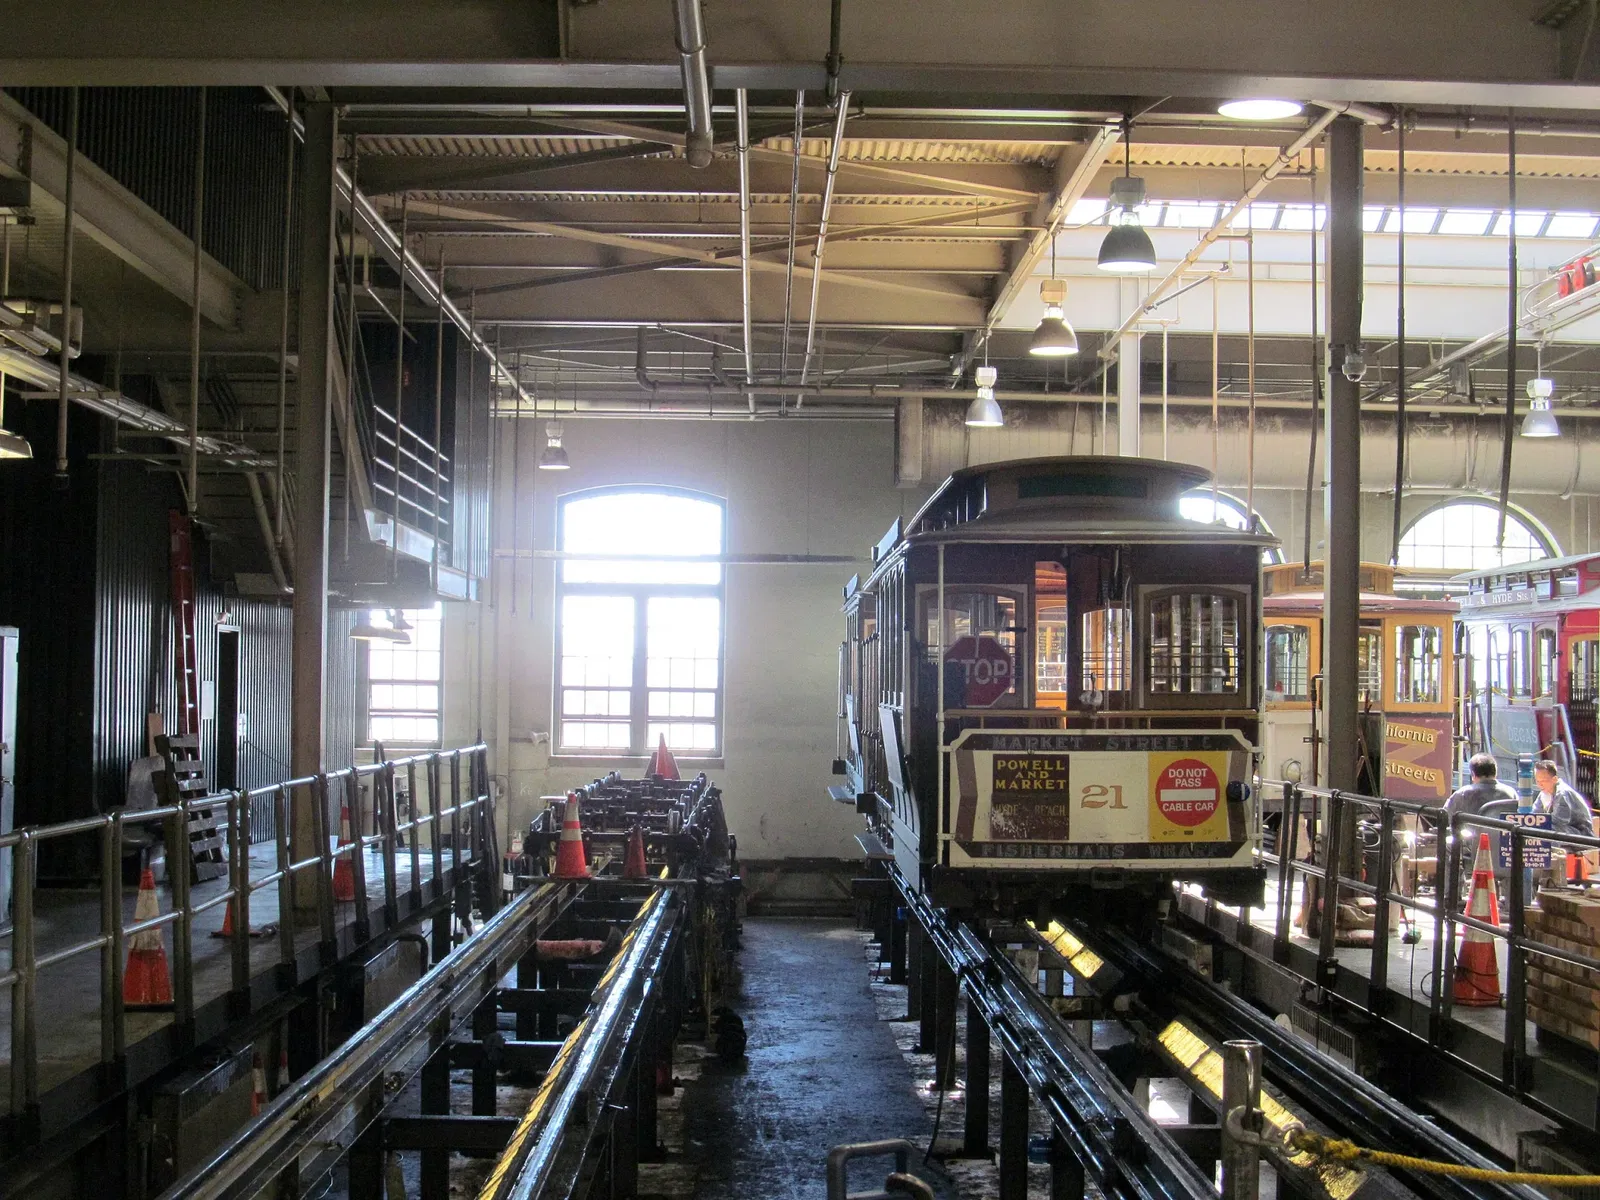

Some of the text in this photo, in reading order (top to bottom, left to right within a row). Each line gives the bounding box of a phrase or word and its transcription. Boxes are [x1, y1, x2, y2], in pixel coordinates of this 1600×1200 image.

[1492, 593, 1513, 604] HYDE
[946, 658, 1009, 685] TOP
[1386, 724, 1434, 743] lifornia
[992, 736, 1083, 750] MARKET
[1106, 736, 1193, 751] STREET
[997, 760, 1065, 770] POWELL
[1015, 771, 1049, 779] AND
[1168, 768, 1208, 778] DO NOT
[995, 779, 1067, 790] MARKET
[1175, 778, 1202, 788] PASS
[1080, 784, 1128, 809] 21
[1162, 802, 1214, 812] CABLE CAR
[1505, 814, 1547, 827] STOP
[981, 843, 1125, 858] FISHERMANS
